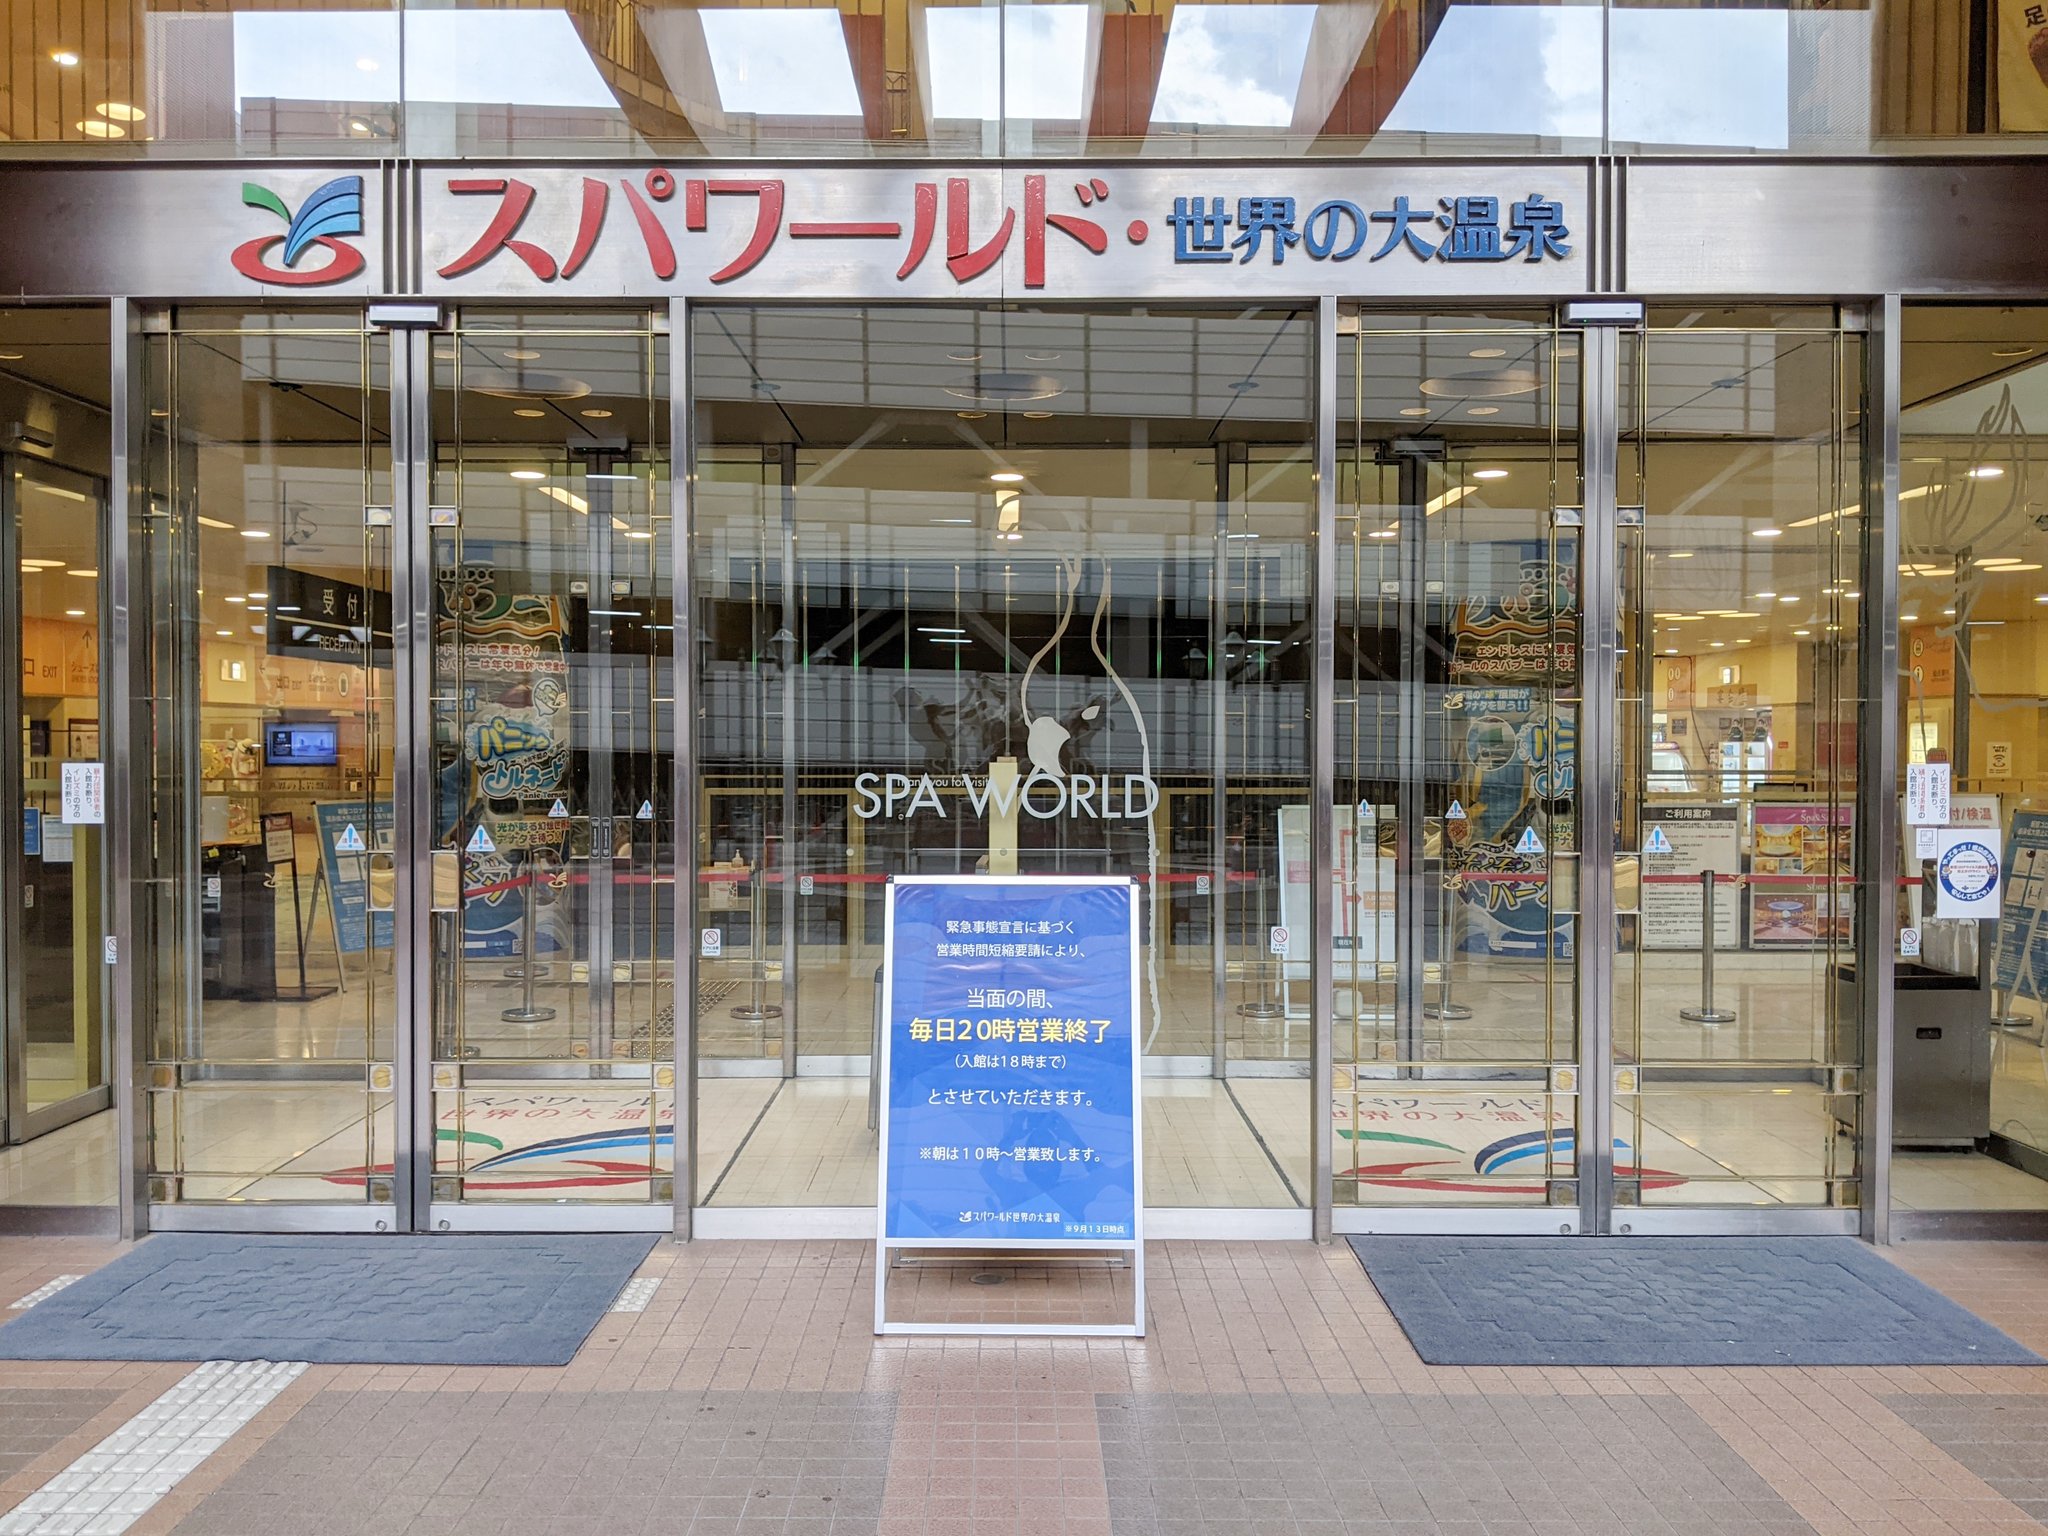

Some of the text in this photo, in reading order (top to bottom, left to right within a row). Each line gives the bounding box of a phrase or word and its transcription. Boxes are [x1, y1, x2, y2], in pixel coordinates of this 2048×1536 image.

[2024, 4, 2048, 28] 足
[1166, 193, 1573, 263] 世界の大温泉
[323, 589, 358, 620] 受付
[319, 635, 361, 654] RECEPTION
[42, 665, 58, 679] EXIT
[71, 661, 98, 673] シューズ
[73, 768, 81, 818] イレズミの方の
[852, 772, 1160, 819] SPA WORLD
[1939, 769, 1948, 819] イレズミの方の
[1665, 808, 1712, 819] ご利用案内
[1949, 807, 1993, 820] 付/検温
[946, 920, 1074, 934] 緊急事態宣言に基づく
[936, 943, 1085, 957] 営業時間短縮要請により、
[967, 988, 1053, 1009] 当面の間、
[909, 1017, 1112, 1043] 毎日20時営業終了
[955, 1055, 1067, 1069] （入館は18時まで）
[465, 1095, 674, 1107] スパワール
[928, 1089, 1093, 1107] とさせていただきます。
[1065, 1224, 1125, 1234] ※9月13日時点
